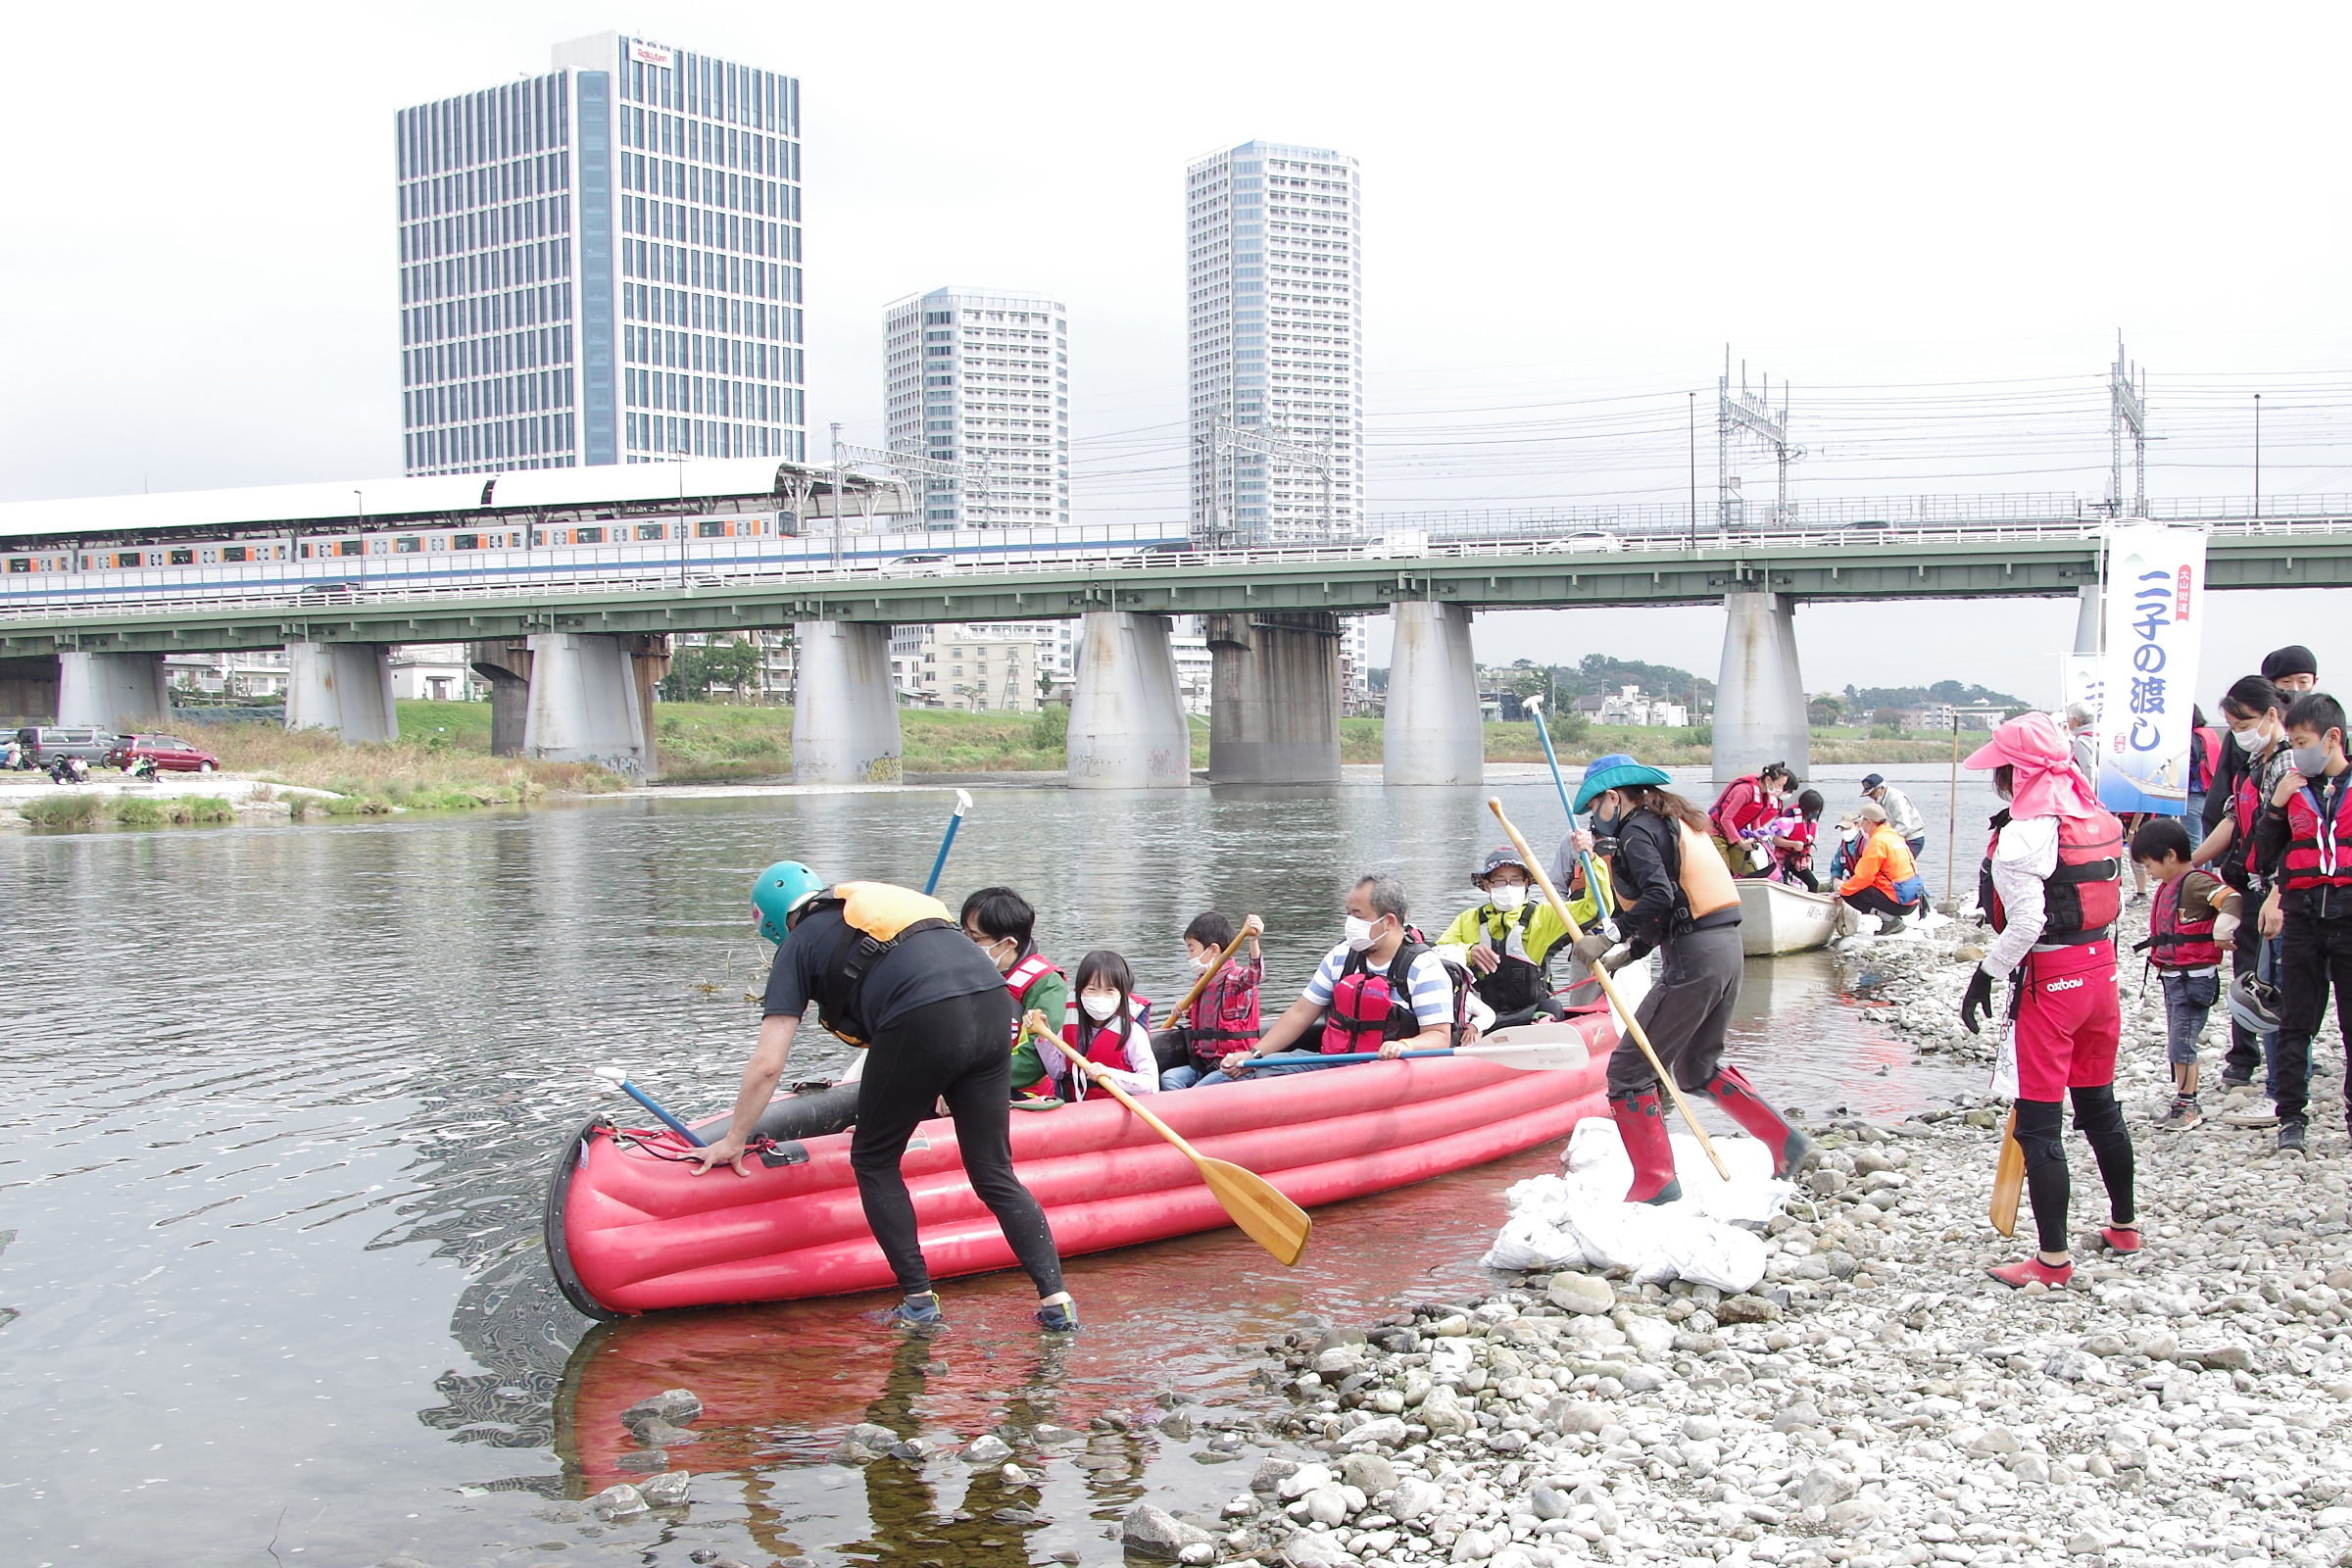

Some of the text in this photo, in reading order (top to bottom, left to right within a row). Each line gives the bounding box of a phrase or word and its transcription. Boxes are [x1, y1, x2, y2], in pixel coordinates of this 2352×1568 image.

[637, 48, 667, 64] Rakuten
[2178, 569, 2190, 613] 大山街道
[2130, 570, 2172, 752] 二子の渡し
[2046, 977, 2083, 993] oxbow
